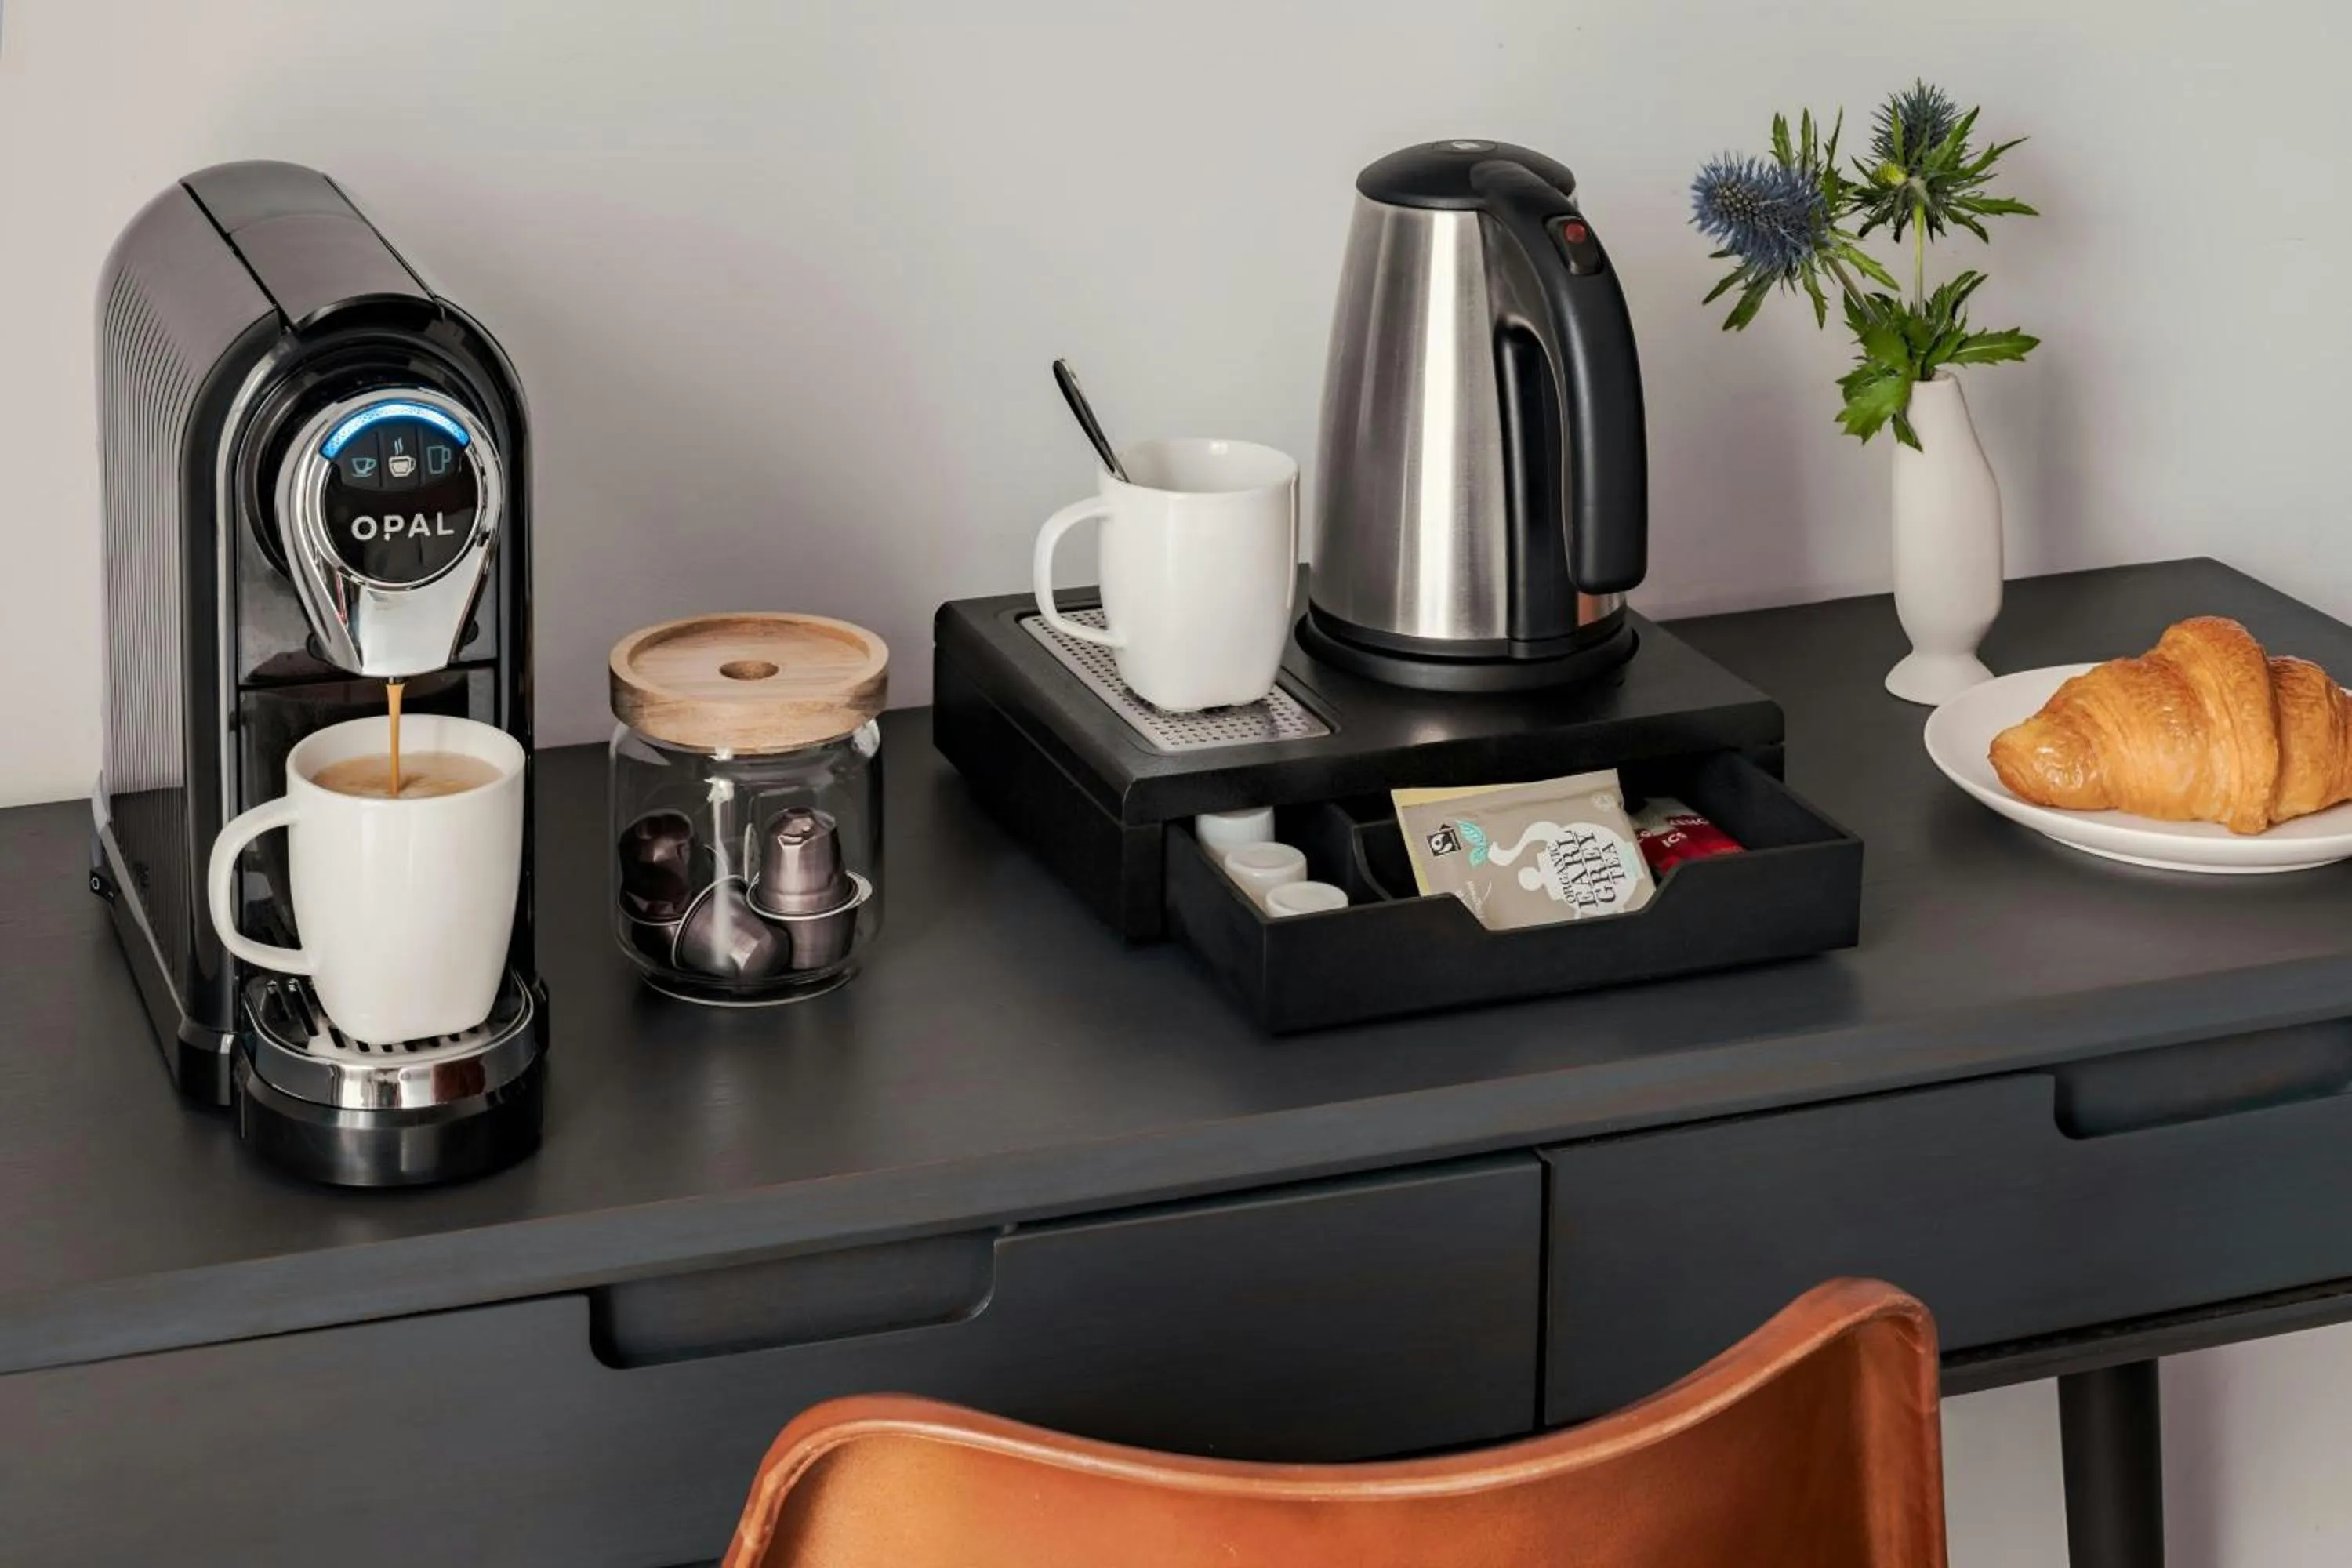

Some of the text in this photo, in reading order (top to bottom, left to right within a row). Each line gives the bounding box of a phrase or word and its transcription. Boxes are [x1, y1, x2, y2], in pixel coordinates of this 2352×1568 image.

[350, 511, 455, 541] OPAL
[1548, 843, 1577, 904] ORGANIC
[1555, 830, 1599, 909] EARL
[1574, 832, 1617, 903] GREY
[1602, 840, 1626, 884] TEA
